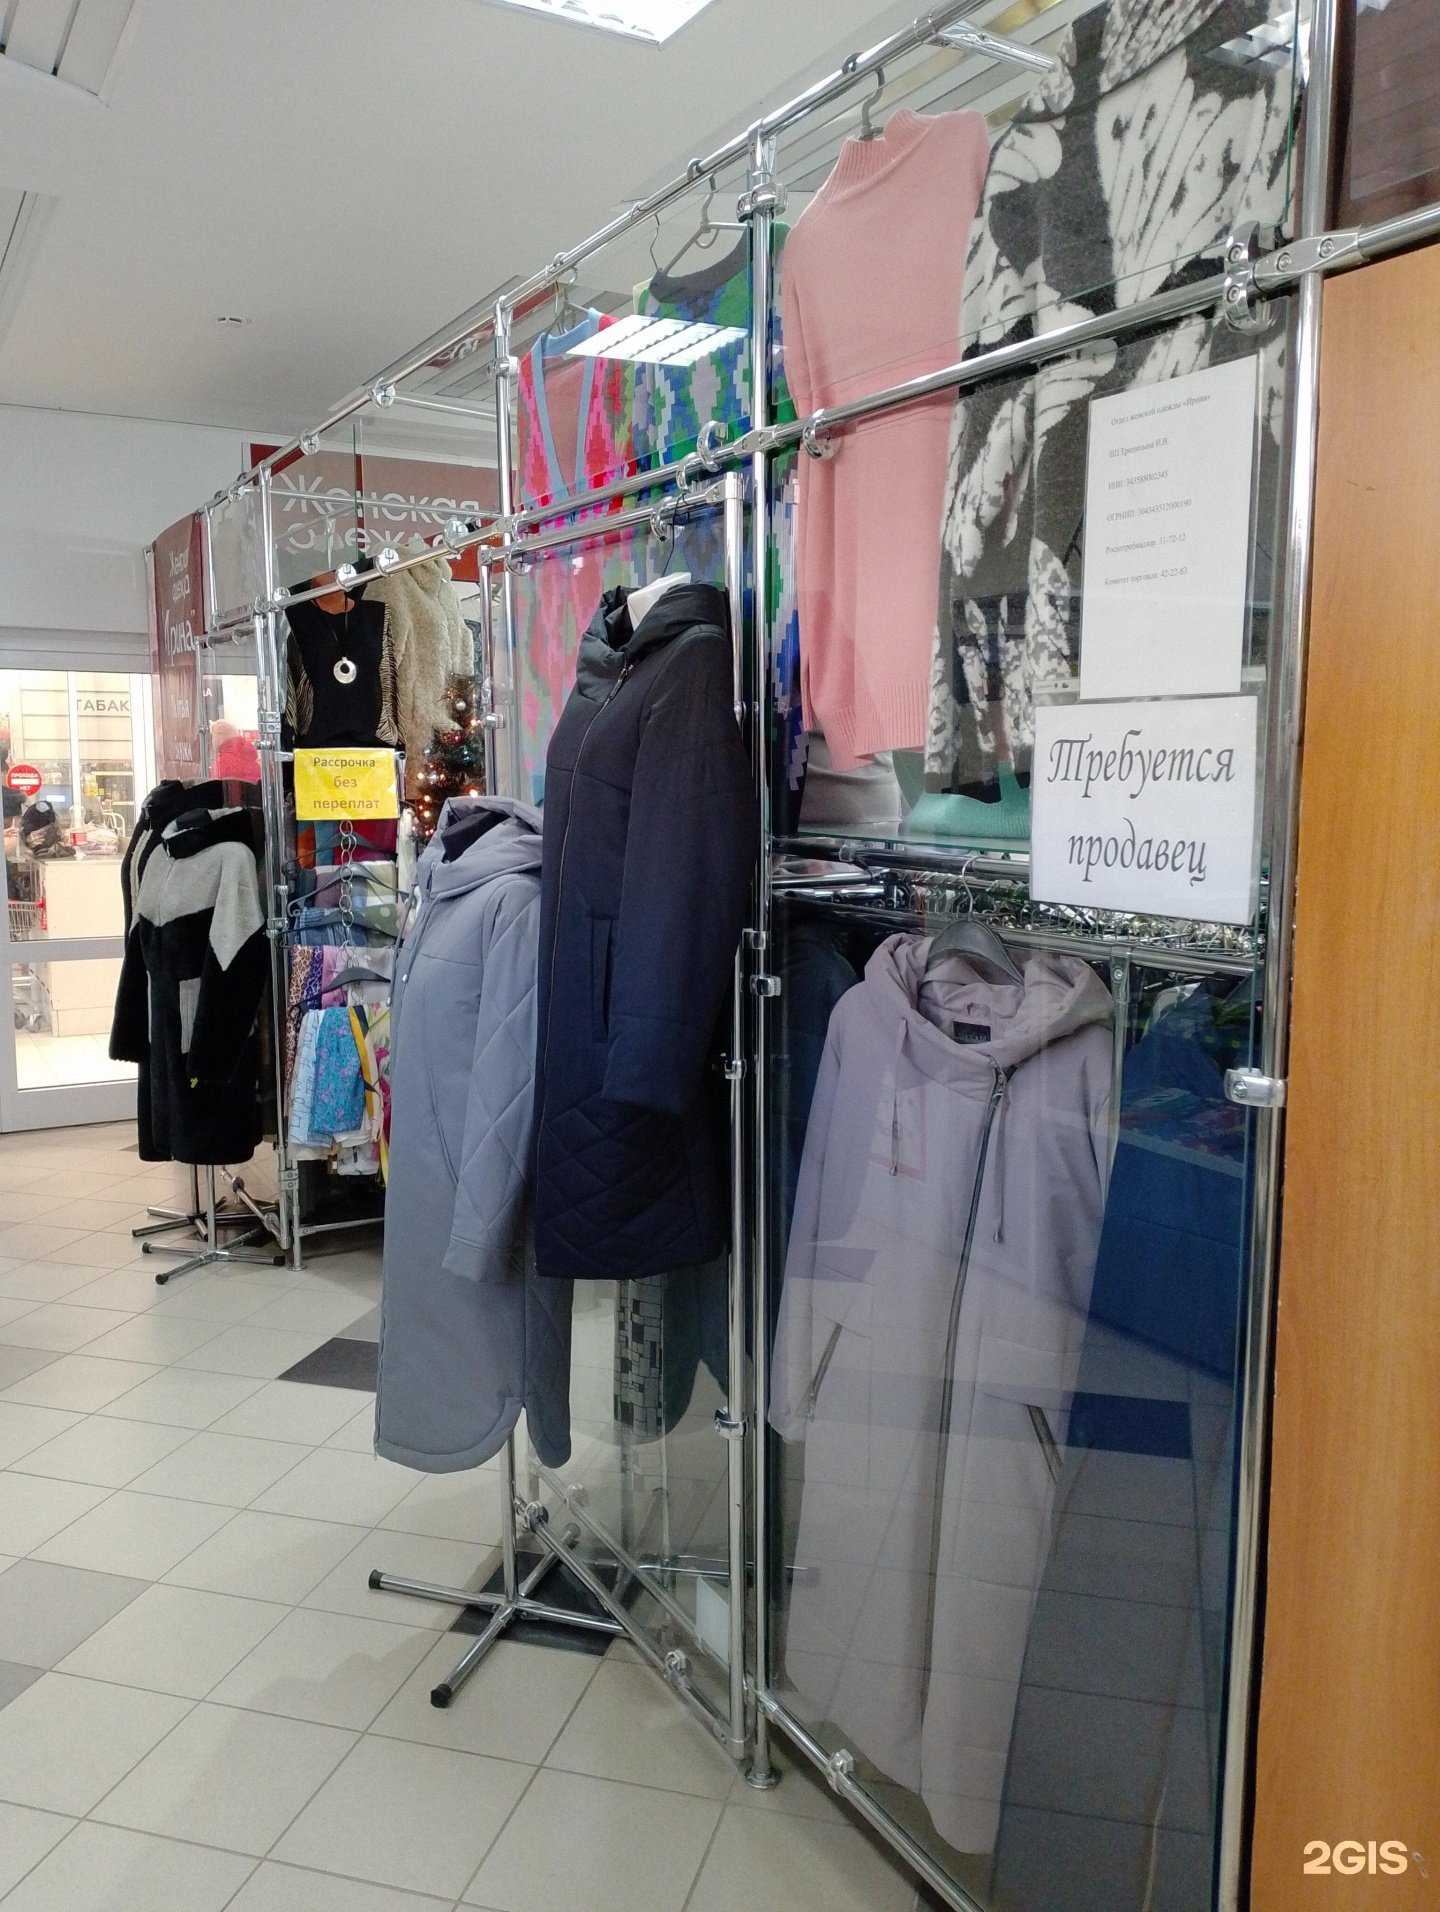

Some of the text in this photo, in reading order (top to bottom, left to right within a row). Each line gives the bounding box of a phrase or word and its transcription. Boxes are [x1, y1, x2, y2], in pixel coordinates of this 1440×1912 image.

[76, 699, 130, 713] ТАБАК
[312, 756, 376, 769] Рассрочка
[1047, 729, 1236, 800] Требуется
[333, 775, 358, 788] без
[313, 799, 380, 812] переплат
[1067, 817, 1208, 887] продавец
